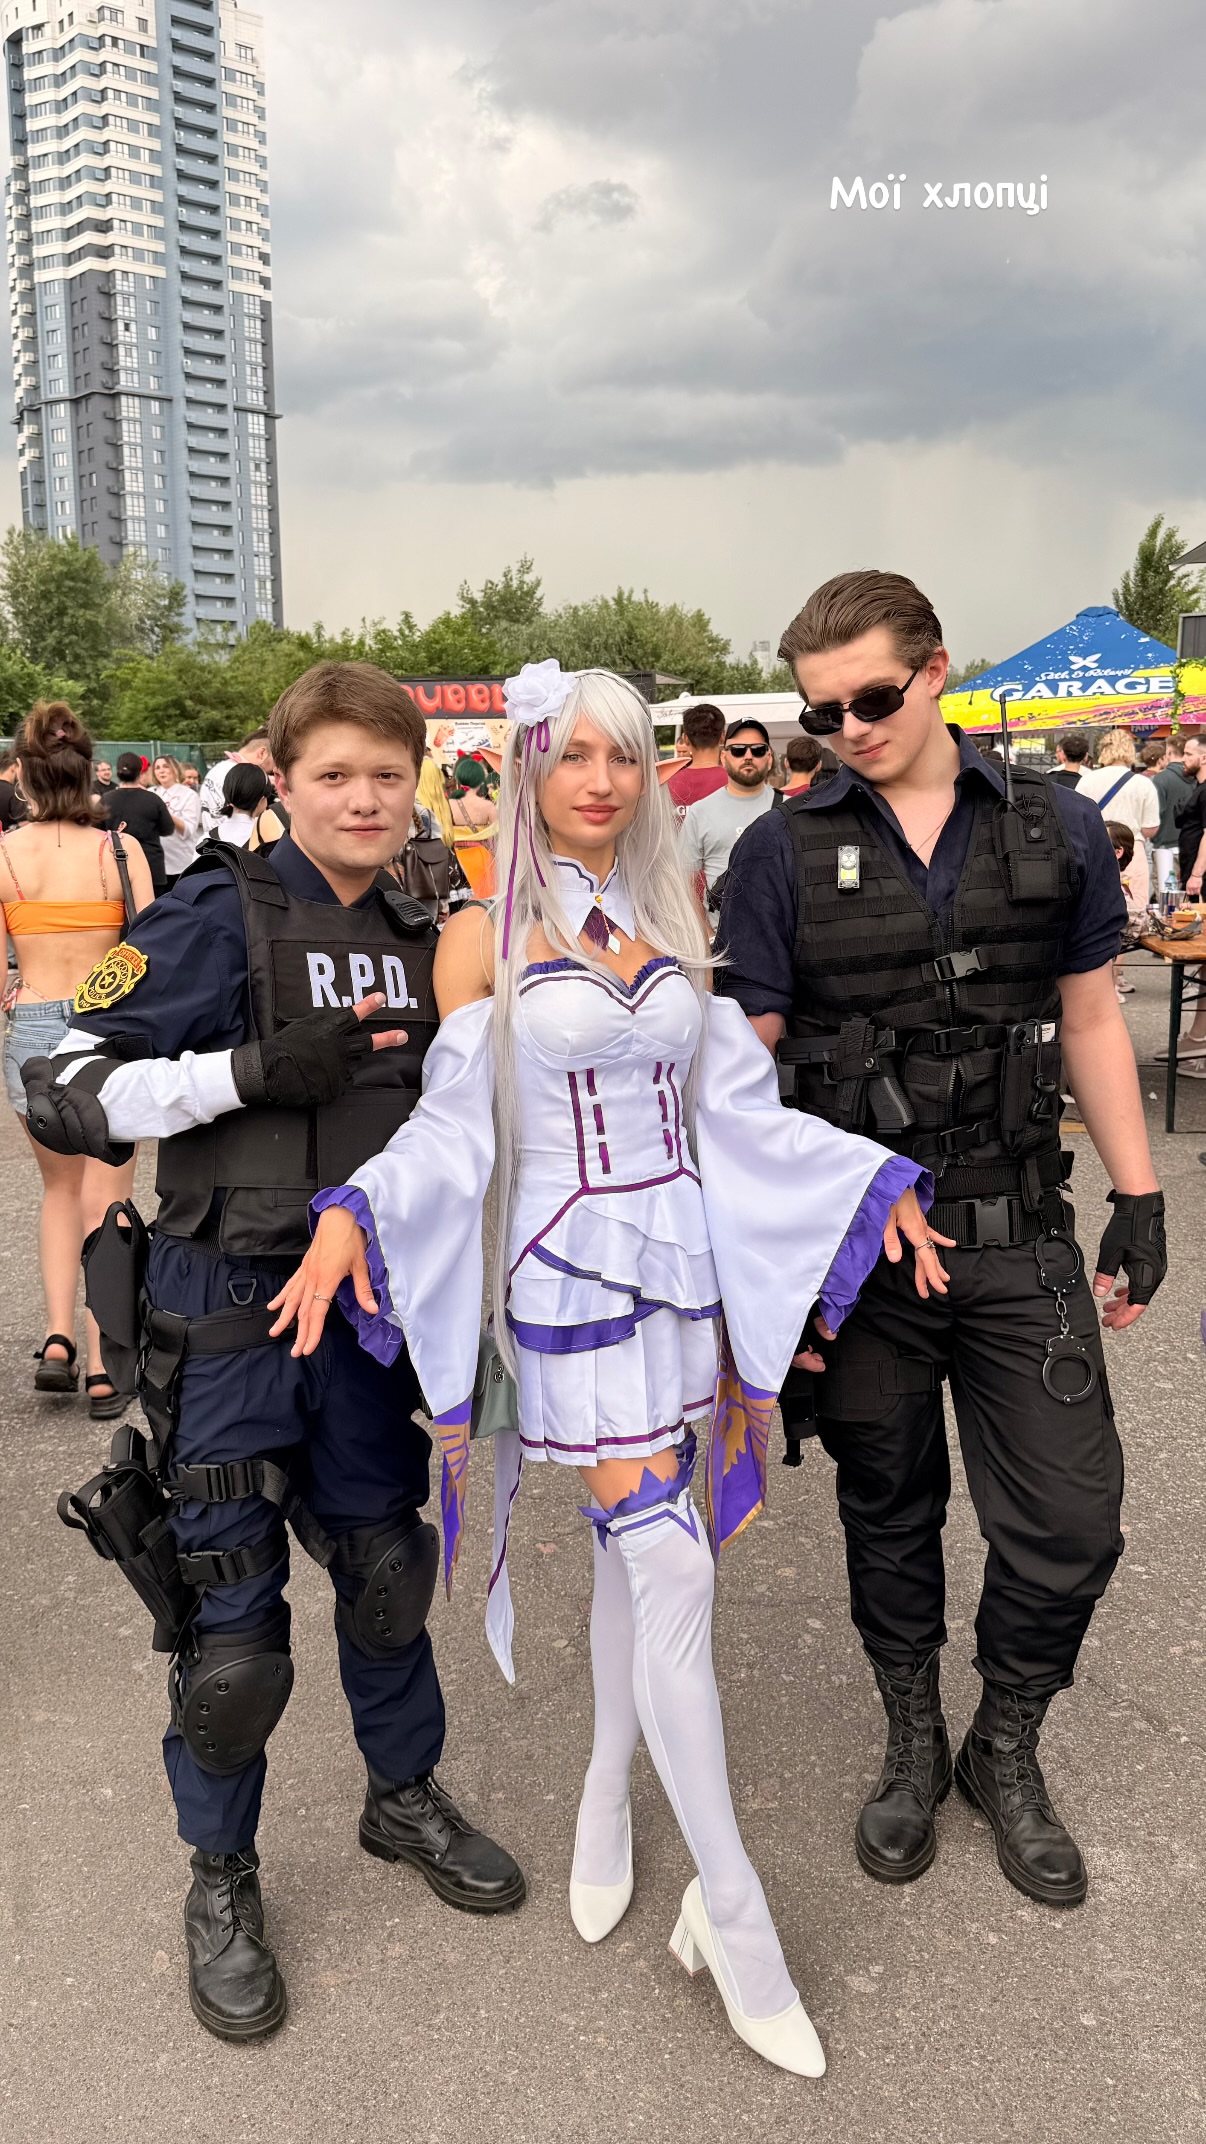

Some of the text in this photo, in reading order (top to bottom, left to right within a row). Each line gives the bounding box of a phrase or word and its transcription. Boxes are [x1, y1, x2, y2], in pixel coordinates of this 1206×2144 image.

[401, 683, 507, 714] UBBL
[992, 676, 1175, 702] GARAGE
[306, 952, 418, 1008] R.P.D.
